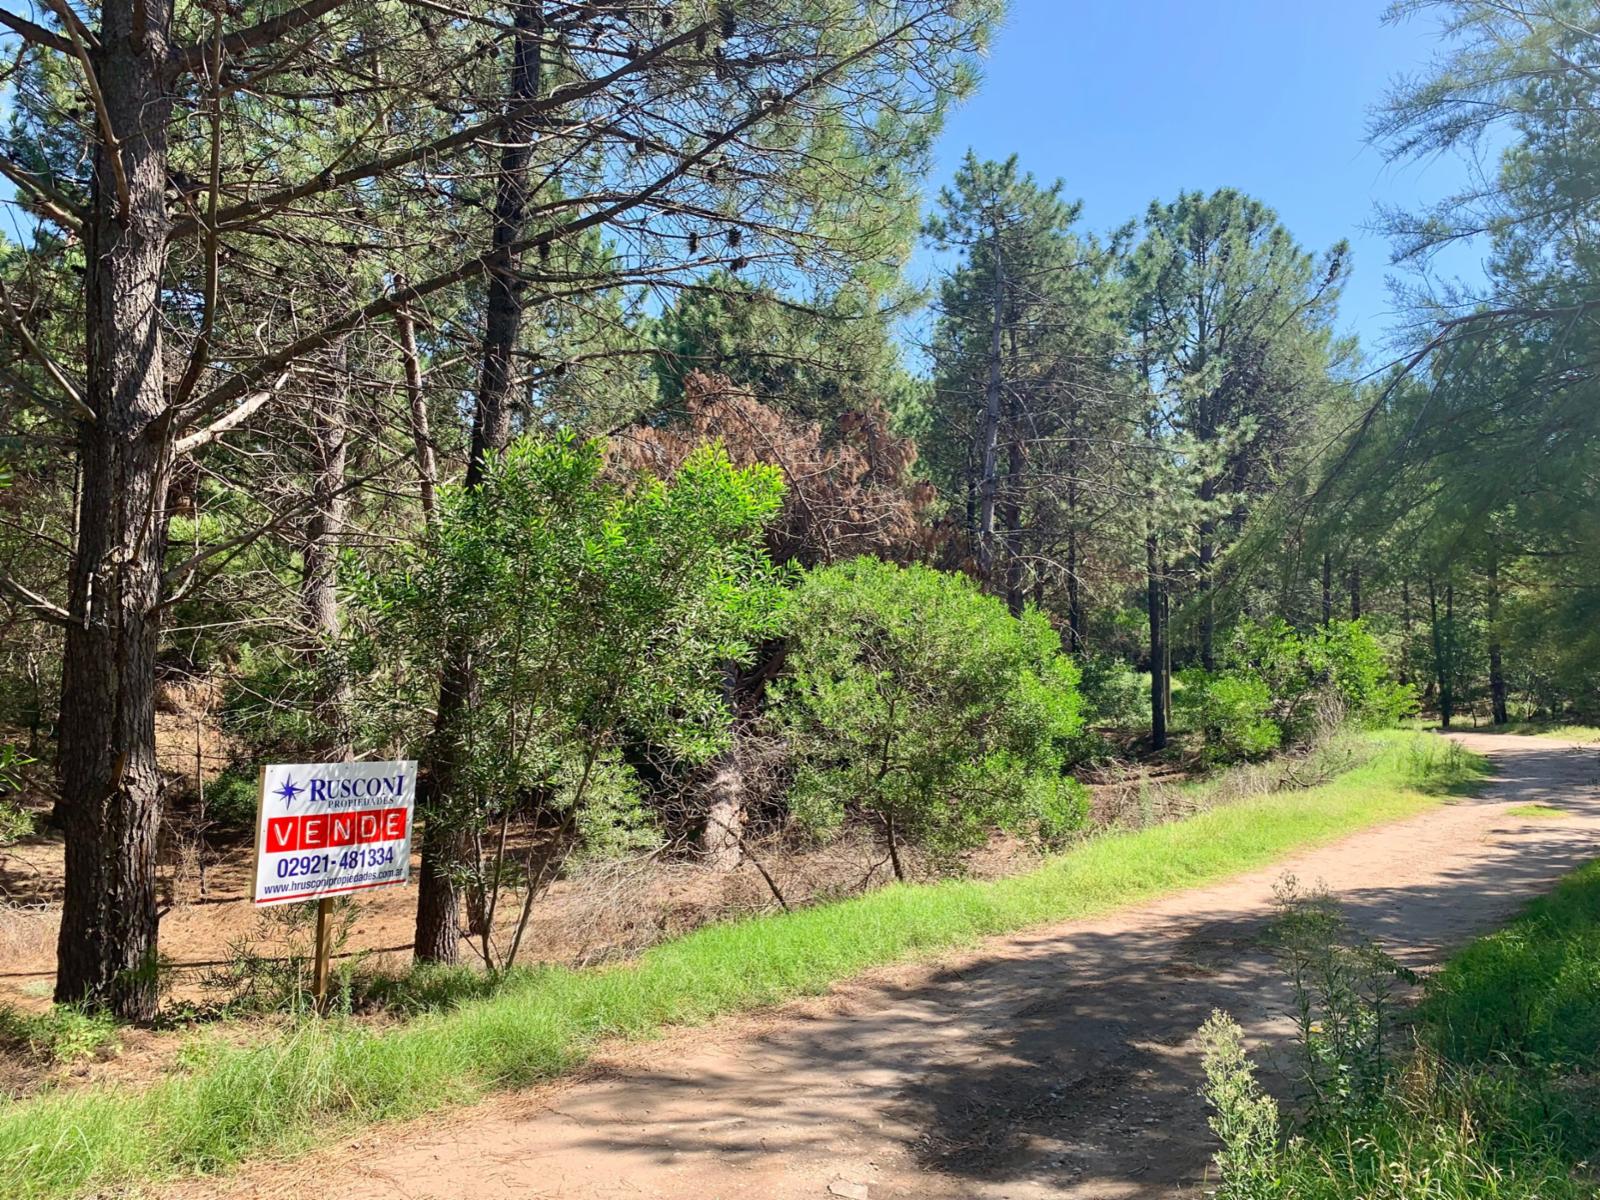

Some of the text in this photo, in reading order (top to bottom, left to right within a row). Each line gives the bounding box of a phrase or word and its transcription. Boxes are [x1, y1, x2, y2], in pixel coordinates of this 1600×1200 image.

[310, 775, 405, 801] RUSCONI
[328, 797, 394, 808] PROPIEDADES
[274, 813, 400, 846] VENDE
[264, 868, 403, 894] www.hrusconipropiedades.com.ar
